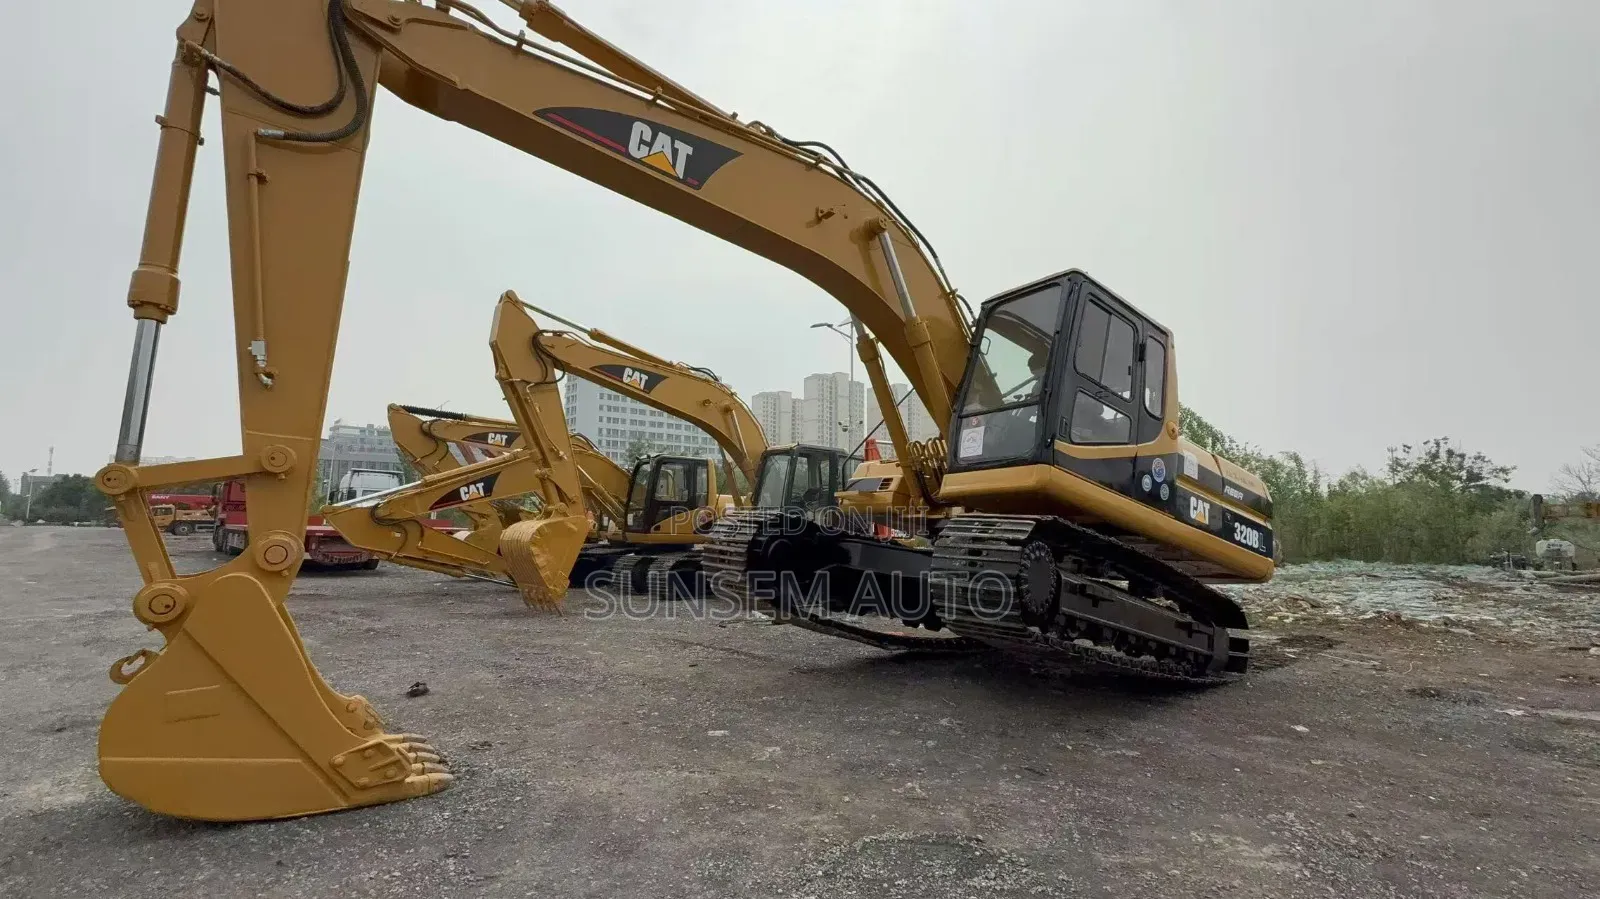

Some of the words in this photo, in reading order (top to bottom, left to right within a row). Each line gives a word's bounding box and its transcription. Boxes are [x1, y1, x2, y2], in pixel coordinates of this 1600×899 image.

[628, 121, 693, 179] CAT
[622, 367, 648, 391] CAT
[487, 432, 508, 446] CAT
[459, 482, 485, 500] CAT
[1190, 496, 1210, 525] CAT
